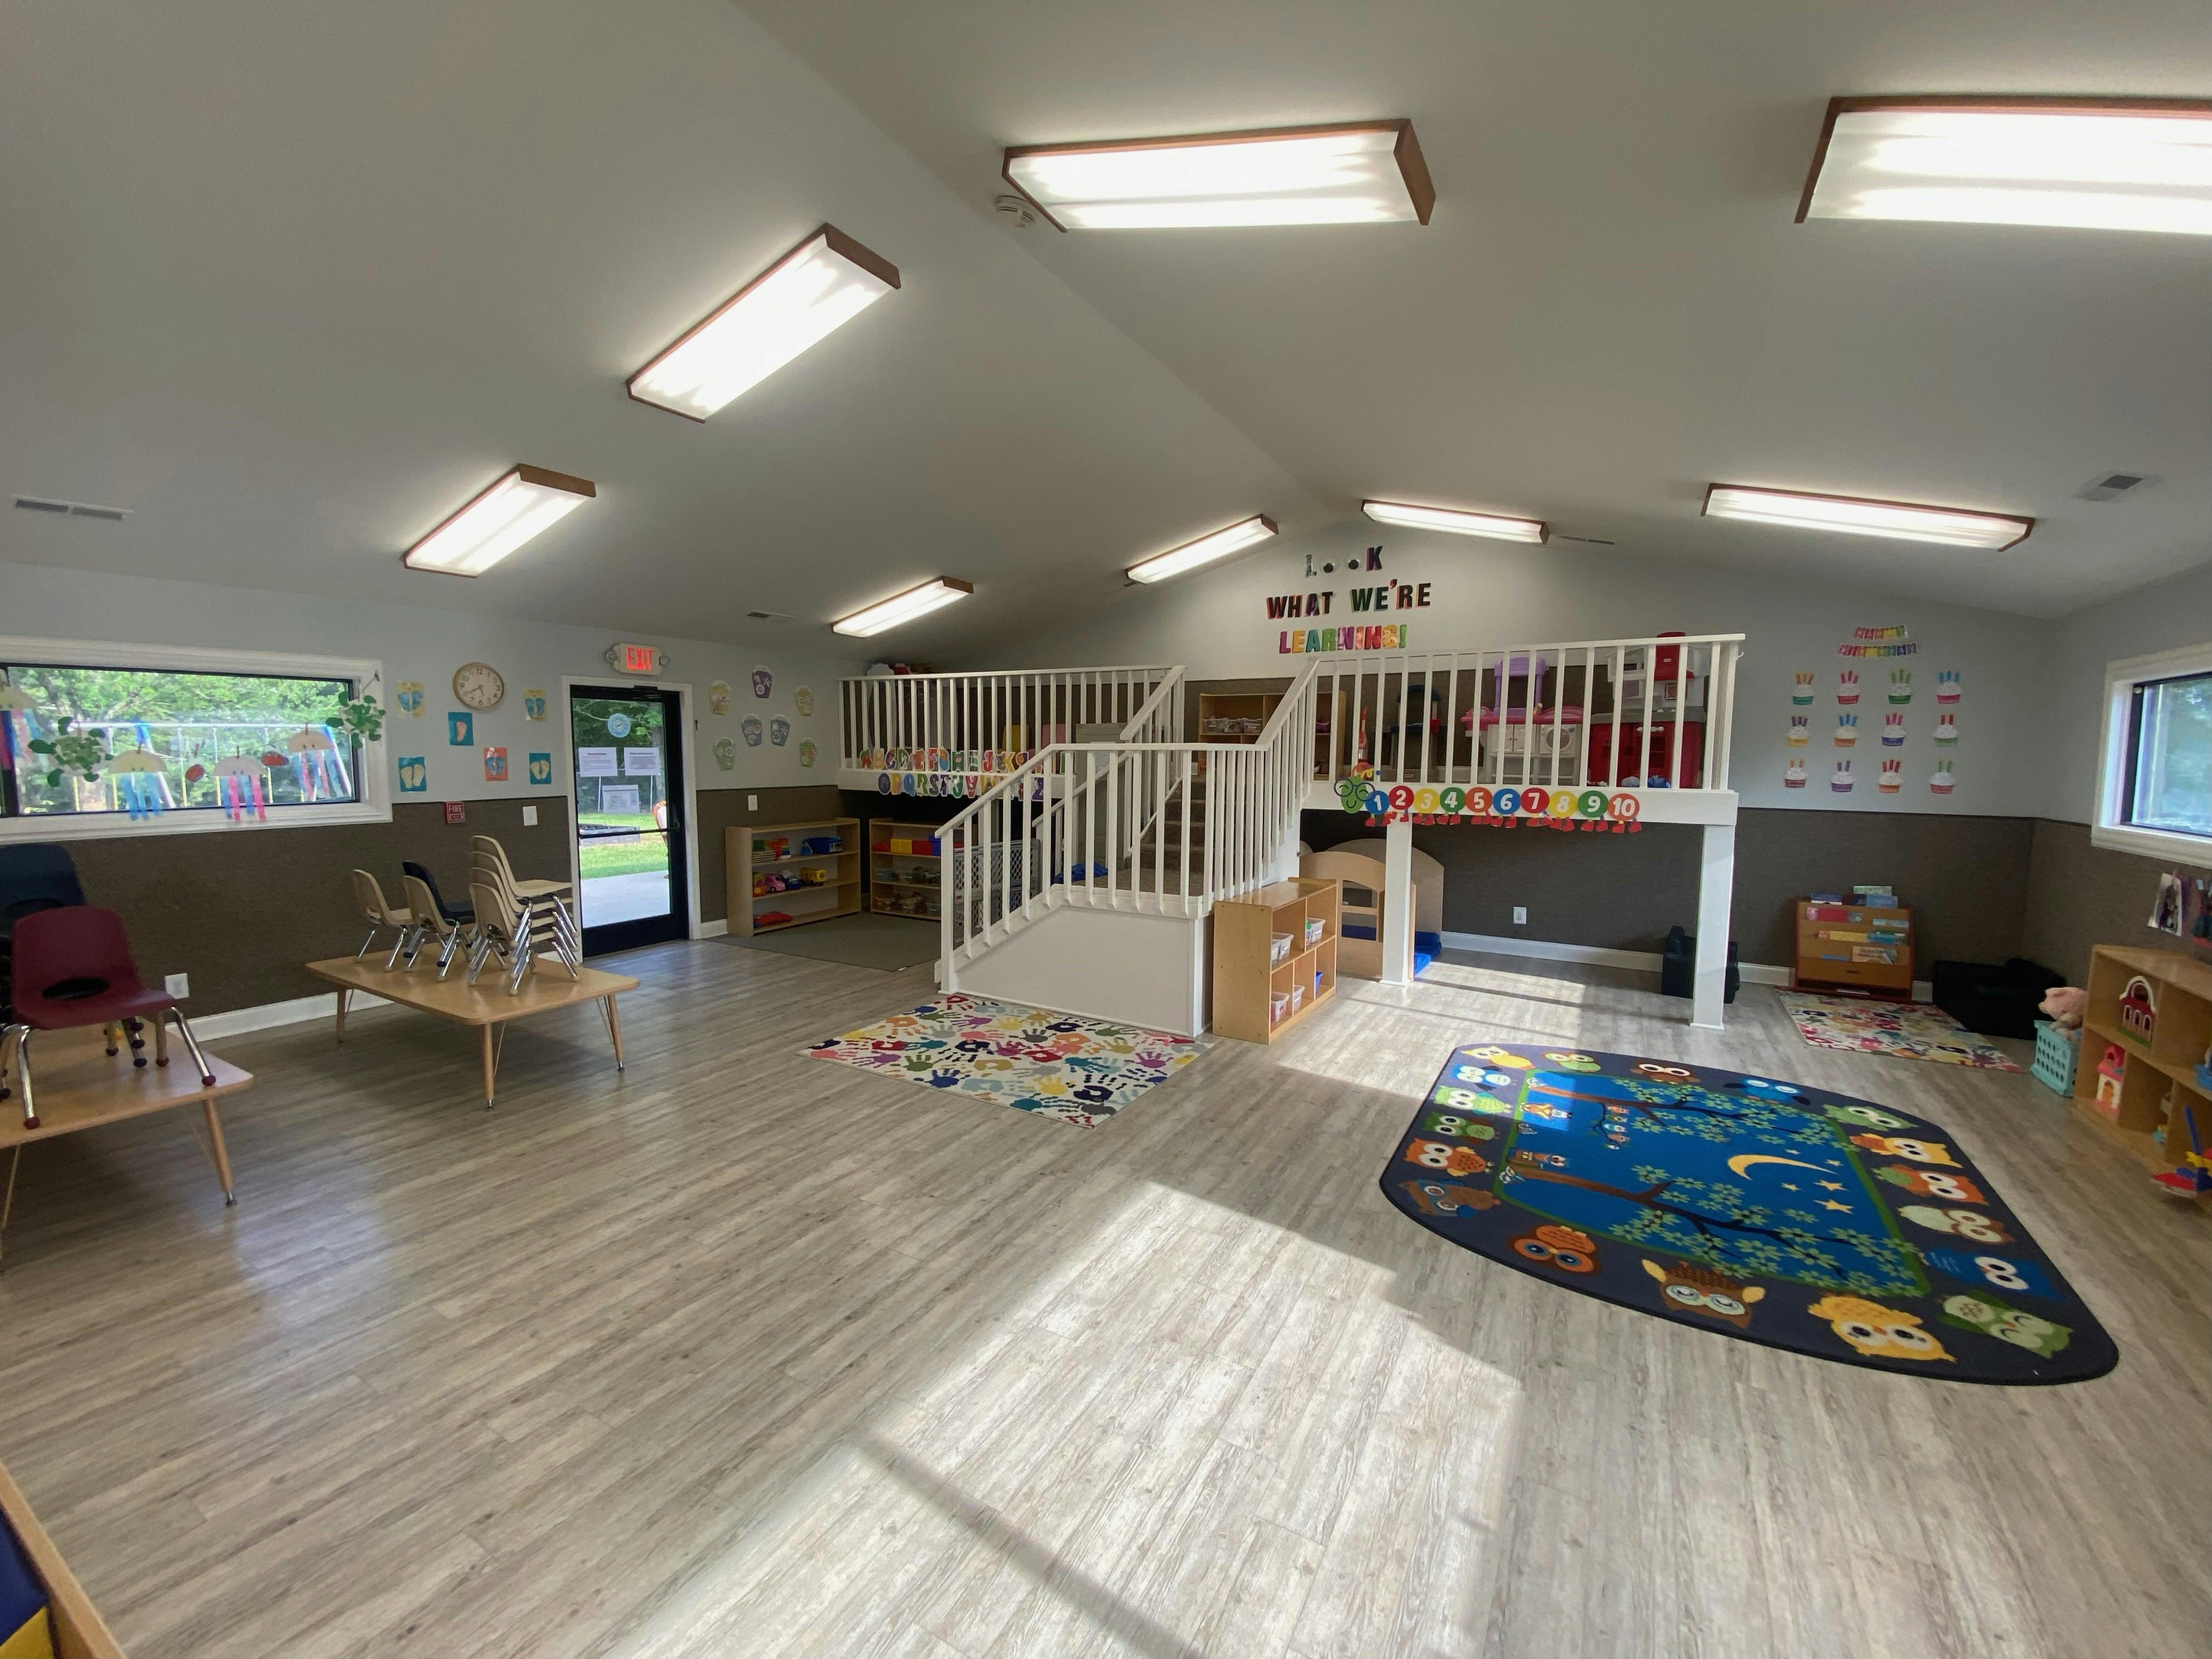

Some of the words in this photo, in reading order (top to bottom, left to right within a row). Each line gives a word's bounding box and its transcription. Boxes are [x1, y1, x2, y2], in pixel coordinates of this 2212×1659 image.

[1266, 591, 1333, 619] WHAT
[1350, 579, 1431, 613] WE'RE
[1279, 624, 1407, 653] LEARNING!
[627, 647, 653, 670] EXIT
[448, 805, 462, 813] FIRE
[1374, 795, 1382, 811] 1
[1395, 789, 1407, 806] 2
[1420, 793, 1433, 809] 3
[1444, 792, 1458, 808] 4
[1474, 792, 1485, 809] 5
[1500, 794, 1513, 810] 6
[1528, 792, 1541, 810] 7
[1556, 795, 1570, 813] 8
[1587, 795, 1601, 812] 9
[1613, 797, 1635, 817] 10
